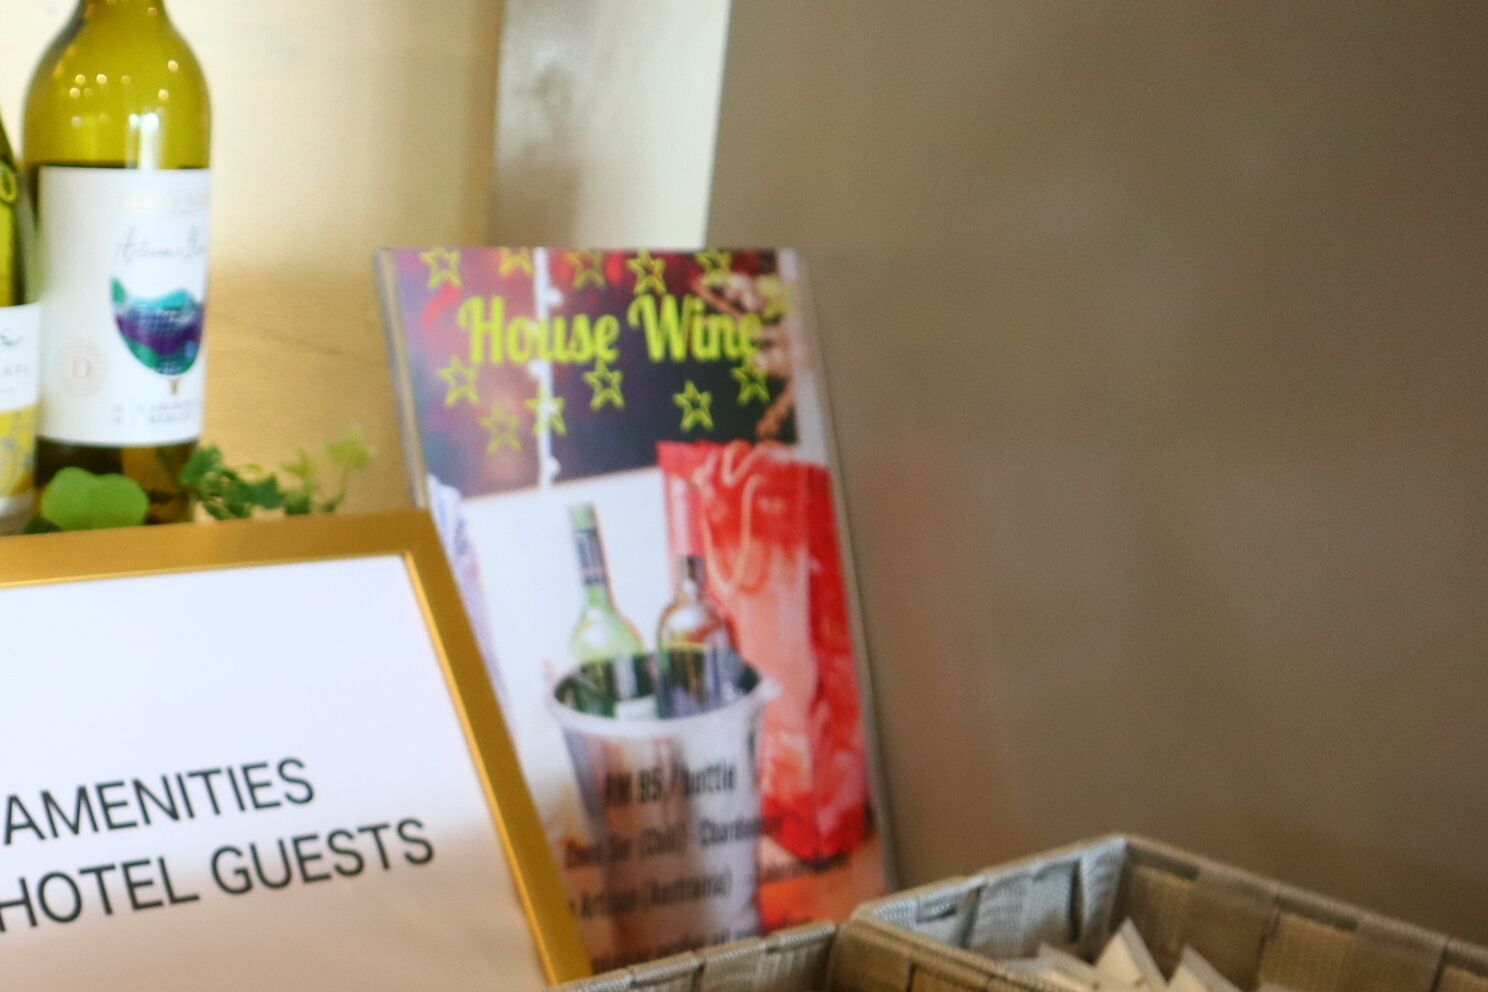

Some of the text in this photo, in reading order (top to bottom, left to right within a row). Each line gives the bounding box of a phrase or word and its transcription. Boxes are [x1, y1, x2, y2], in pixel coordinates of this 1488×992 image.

[457, 294, 761, 364] House Wine
[3, 757, 315, 845] AMENITIES
[211, 817, 434, 894] GUESTS
